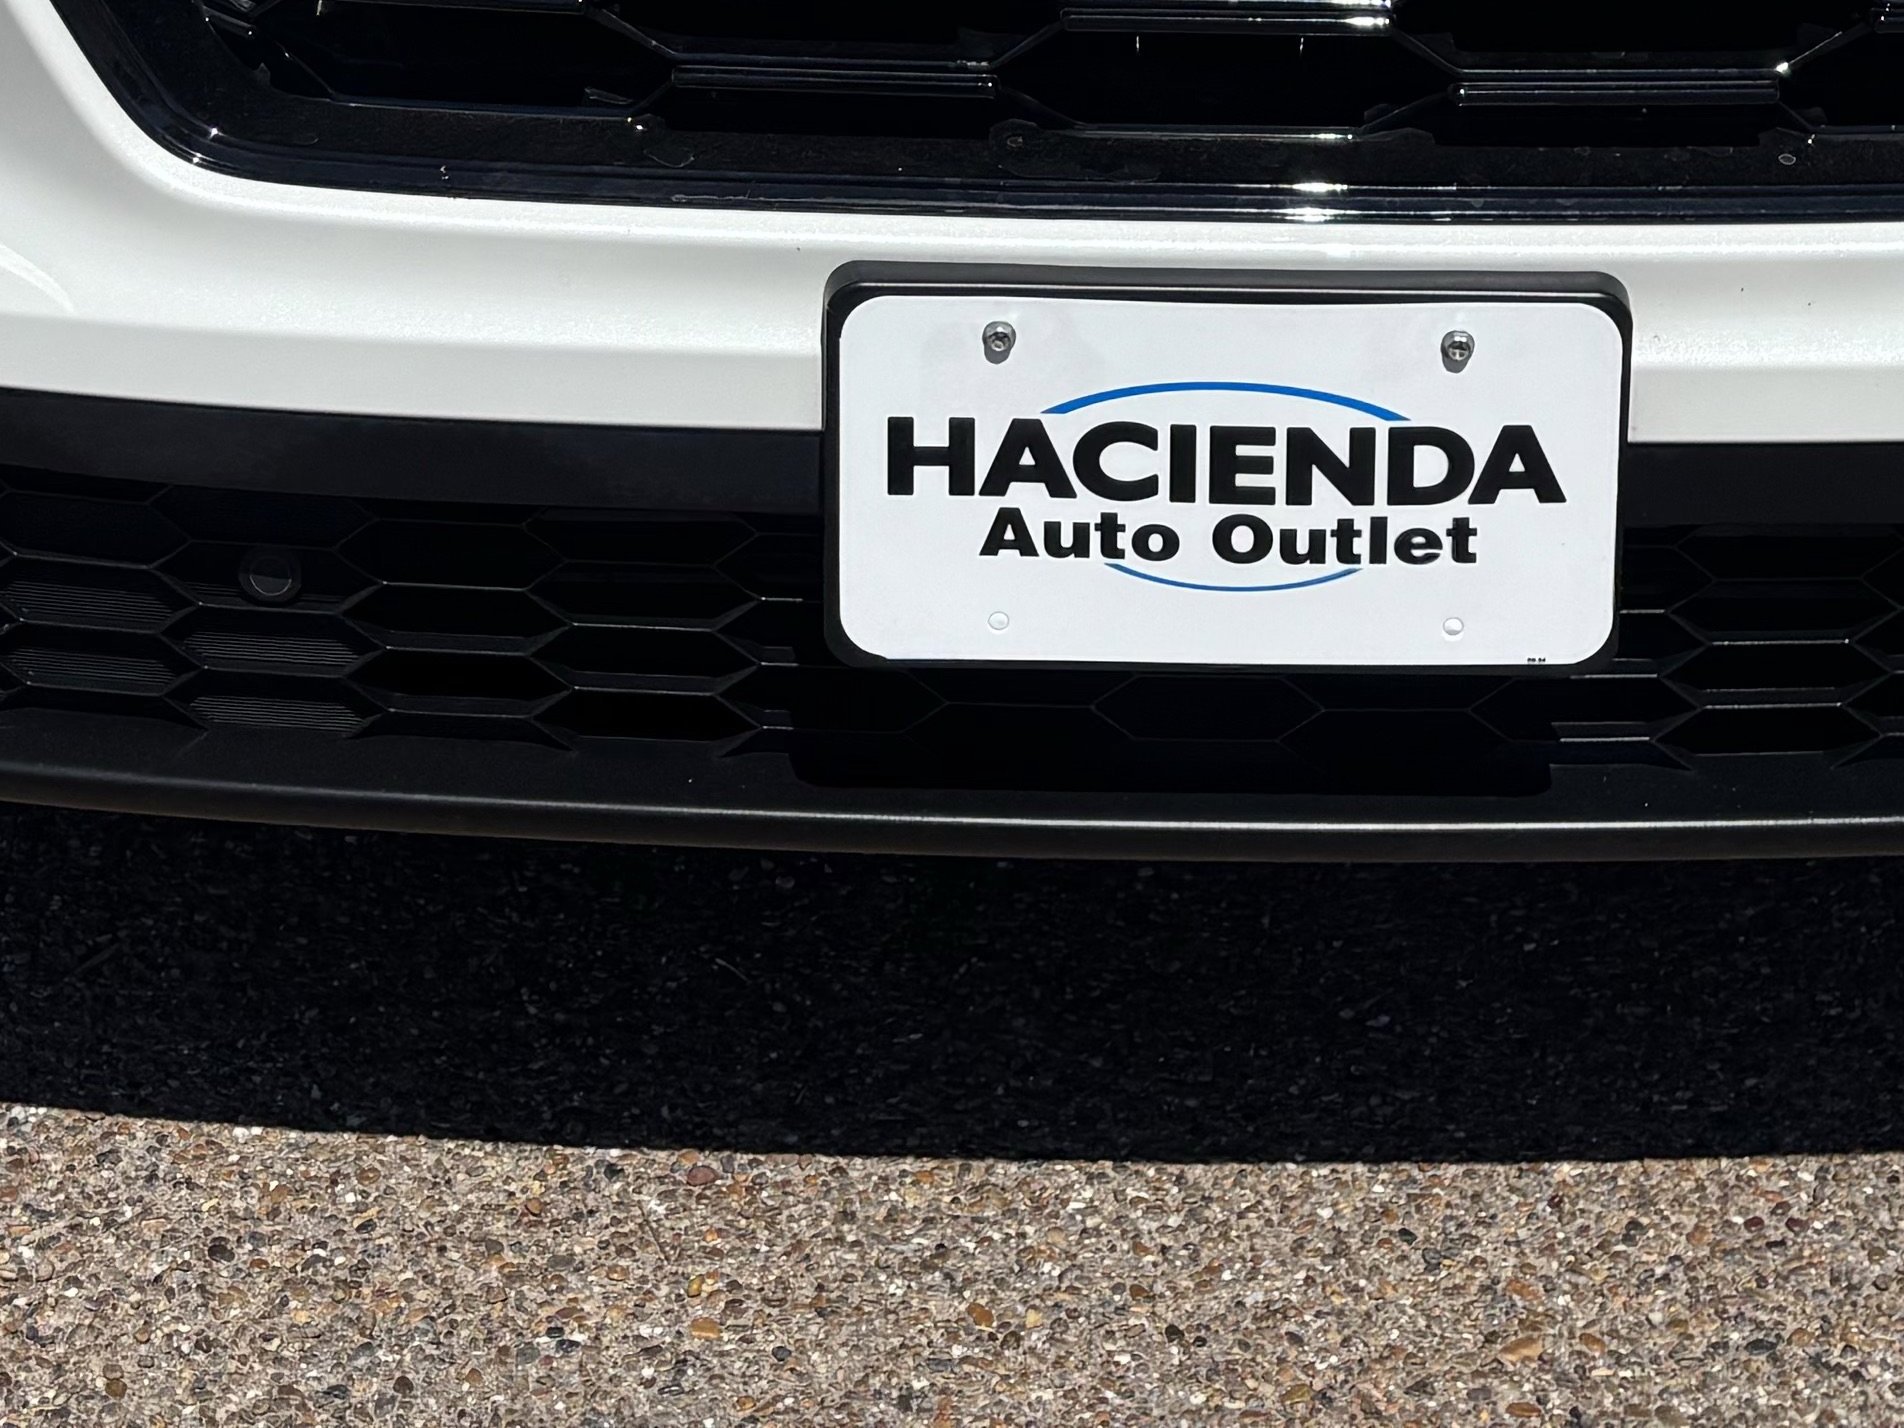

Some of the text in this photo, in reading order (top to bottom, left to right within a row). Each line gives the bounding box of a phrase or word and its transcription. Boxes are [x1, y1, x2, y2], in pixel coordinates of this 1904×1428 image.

[886, 415, 1567, 506] HACIENDA
[978, 506, 1479, 567] Auto Outlet
